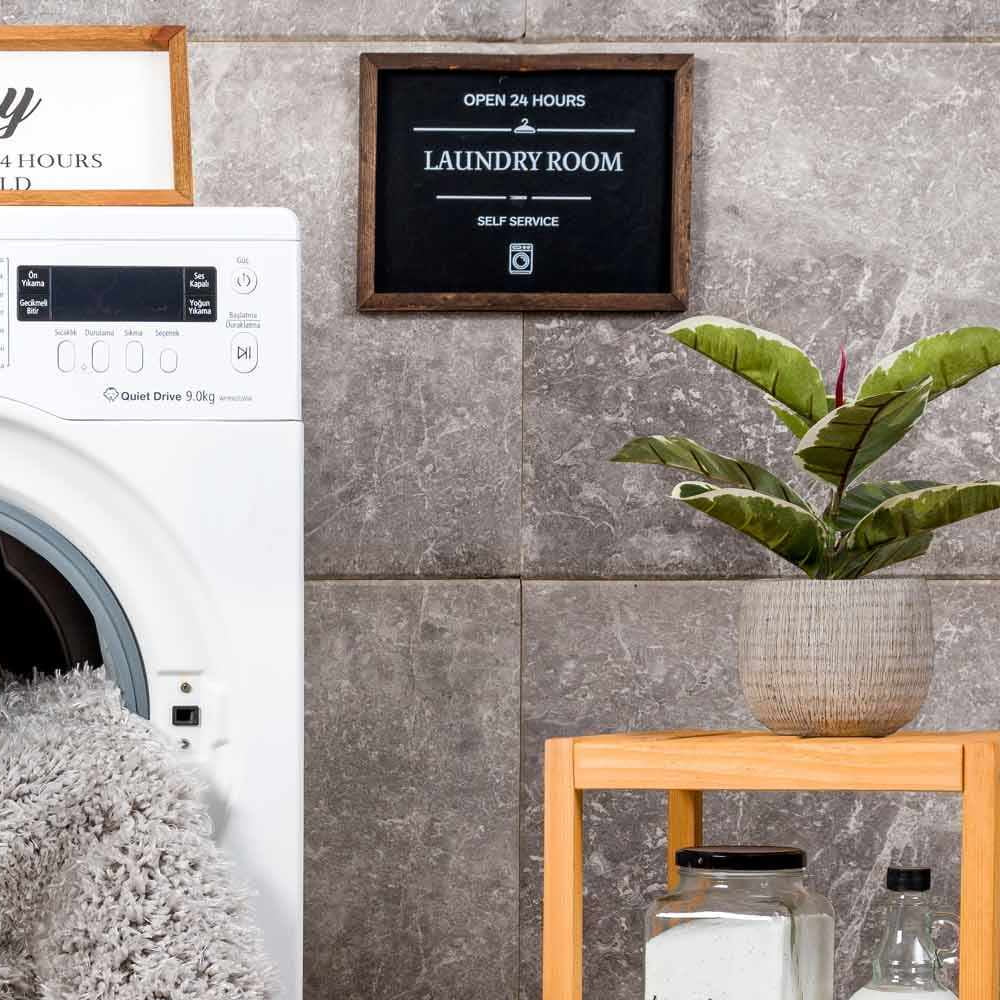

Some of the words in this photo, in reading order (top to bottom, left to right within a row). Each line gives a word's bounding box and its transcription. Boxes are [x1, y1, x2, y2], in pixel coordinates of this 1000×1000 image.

[463, 93, 506, 107] OPEN
[509, 93, 528, 107] 24
[532, 94, 586, 108] HOURS
[18, 153, 103, 169] HOURS
[423, 150, 542, 172] LAUNDRY
[546, 150, 624, 172] ROOM
[477, 215, 507, 227] SELF
[509, 215, 560, 227] SERVICE
[193, 272, 205, 280] Ses
[121, 391, 151, 401] Quiet
[153, 391, 182, 402] Drive
[185, 390, 216, 405] 9.0kg
